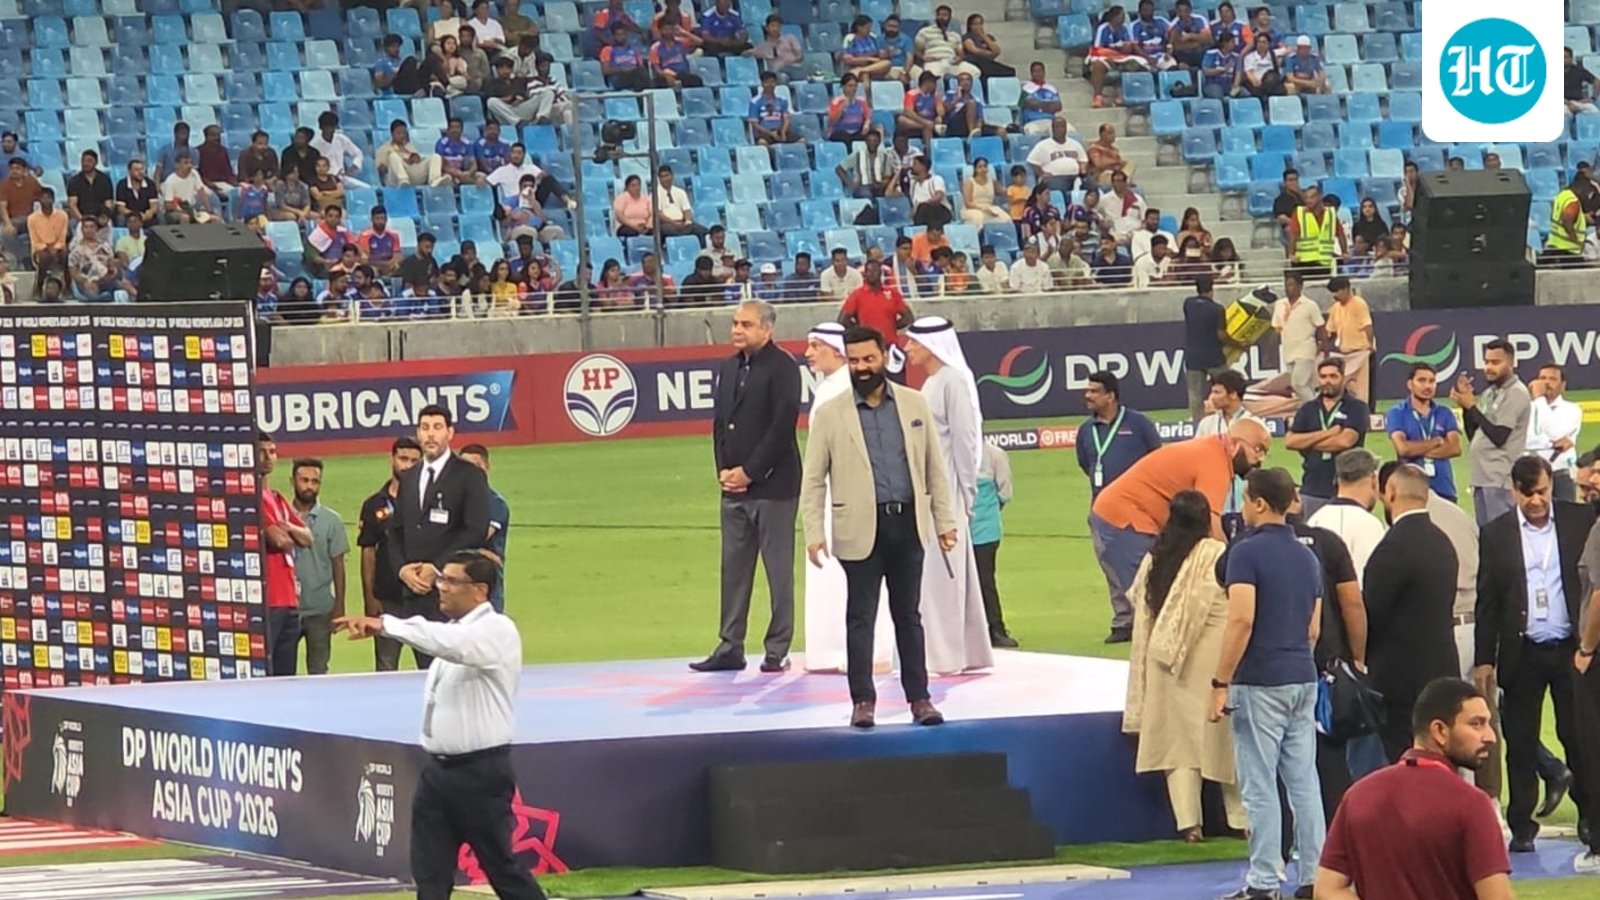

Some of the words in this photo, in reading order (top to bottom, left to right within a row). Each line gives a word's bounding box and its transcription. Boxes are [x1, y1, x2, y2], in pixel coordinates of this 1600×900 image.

[1474, 333, 1540, 370] DP
[1546, 331, 1600, 366] W
[582, 367, 620, 391] HP
[657, 370, 720, 411] NE
[1065, 353, 1129, 390] DP
[122, 726, 147, 768] DP
[150, 730, 214, 778] WORLD
[217, 739, 303, 793] WOMEN'S
[152, 779, 195, 824] ASIA
[197, 785, 233, 829] CUP
[235, 791, 279, 838] 2026
